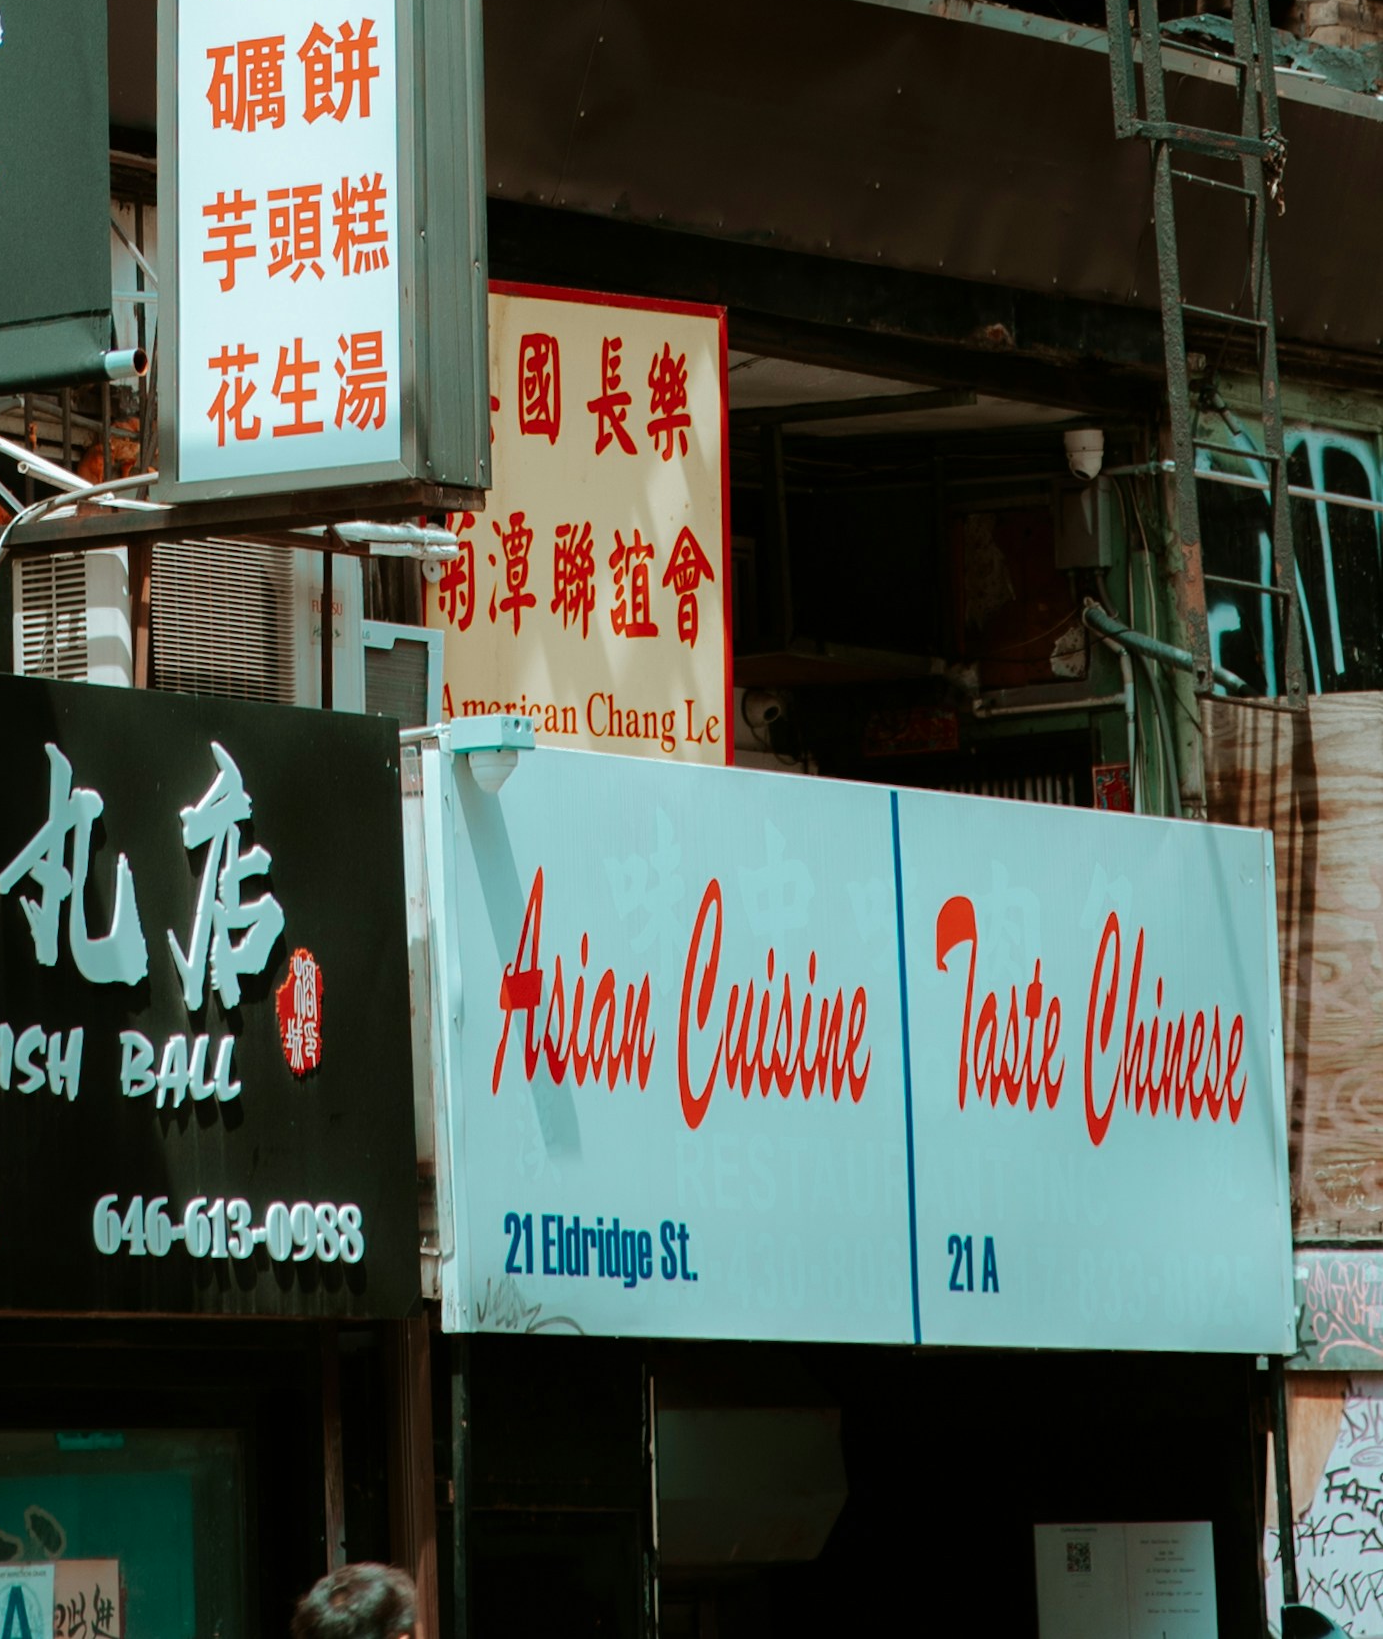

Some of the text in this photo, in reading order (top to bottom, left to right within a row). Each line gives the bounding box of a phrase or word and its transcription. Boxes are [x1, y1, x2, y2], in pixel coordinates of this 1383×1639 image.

[202, 172, 390, 292] 芋頭糕
[207, 331, 388, 447] 花生湯
[489, 332, 692, 462] 國長樂
[587, 692, 676, 752] Chang
[685, 699, 721, 745] Le
[492, 866, 655, 1095] Asian
[678, 878, 870, 1130] Cuisine
[936, 895, 1247, 1147] Taste Chinese
[119, 1031, 242, 1108] BALL
[93, 1194, 365, 1264] 646-613-0988
[504, 1212, 698, 1288] 21 Eldridge St.
[948, 1234, 1000, 1293] 21 A
